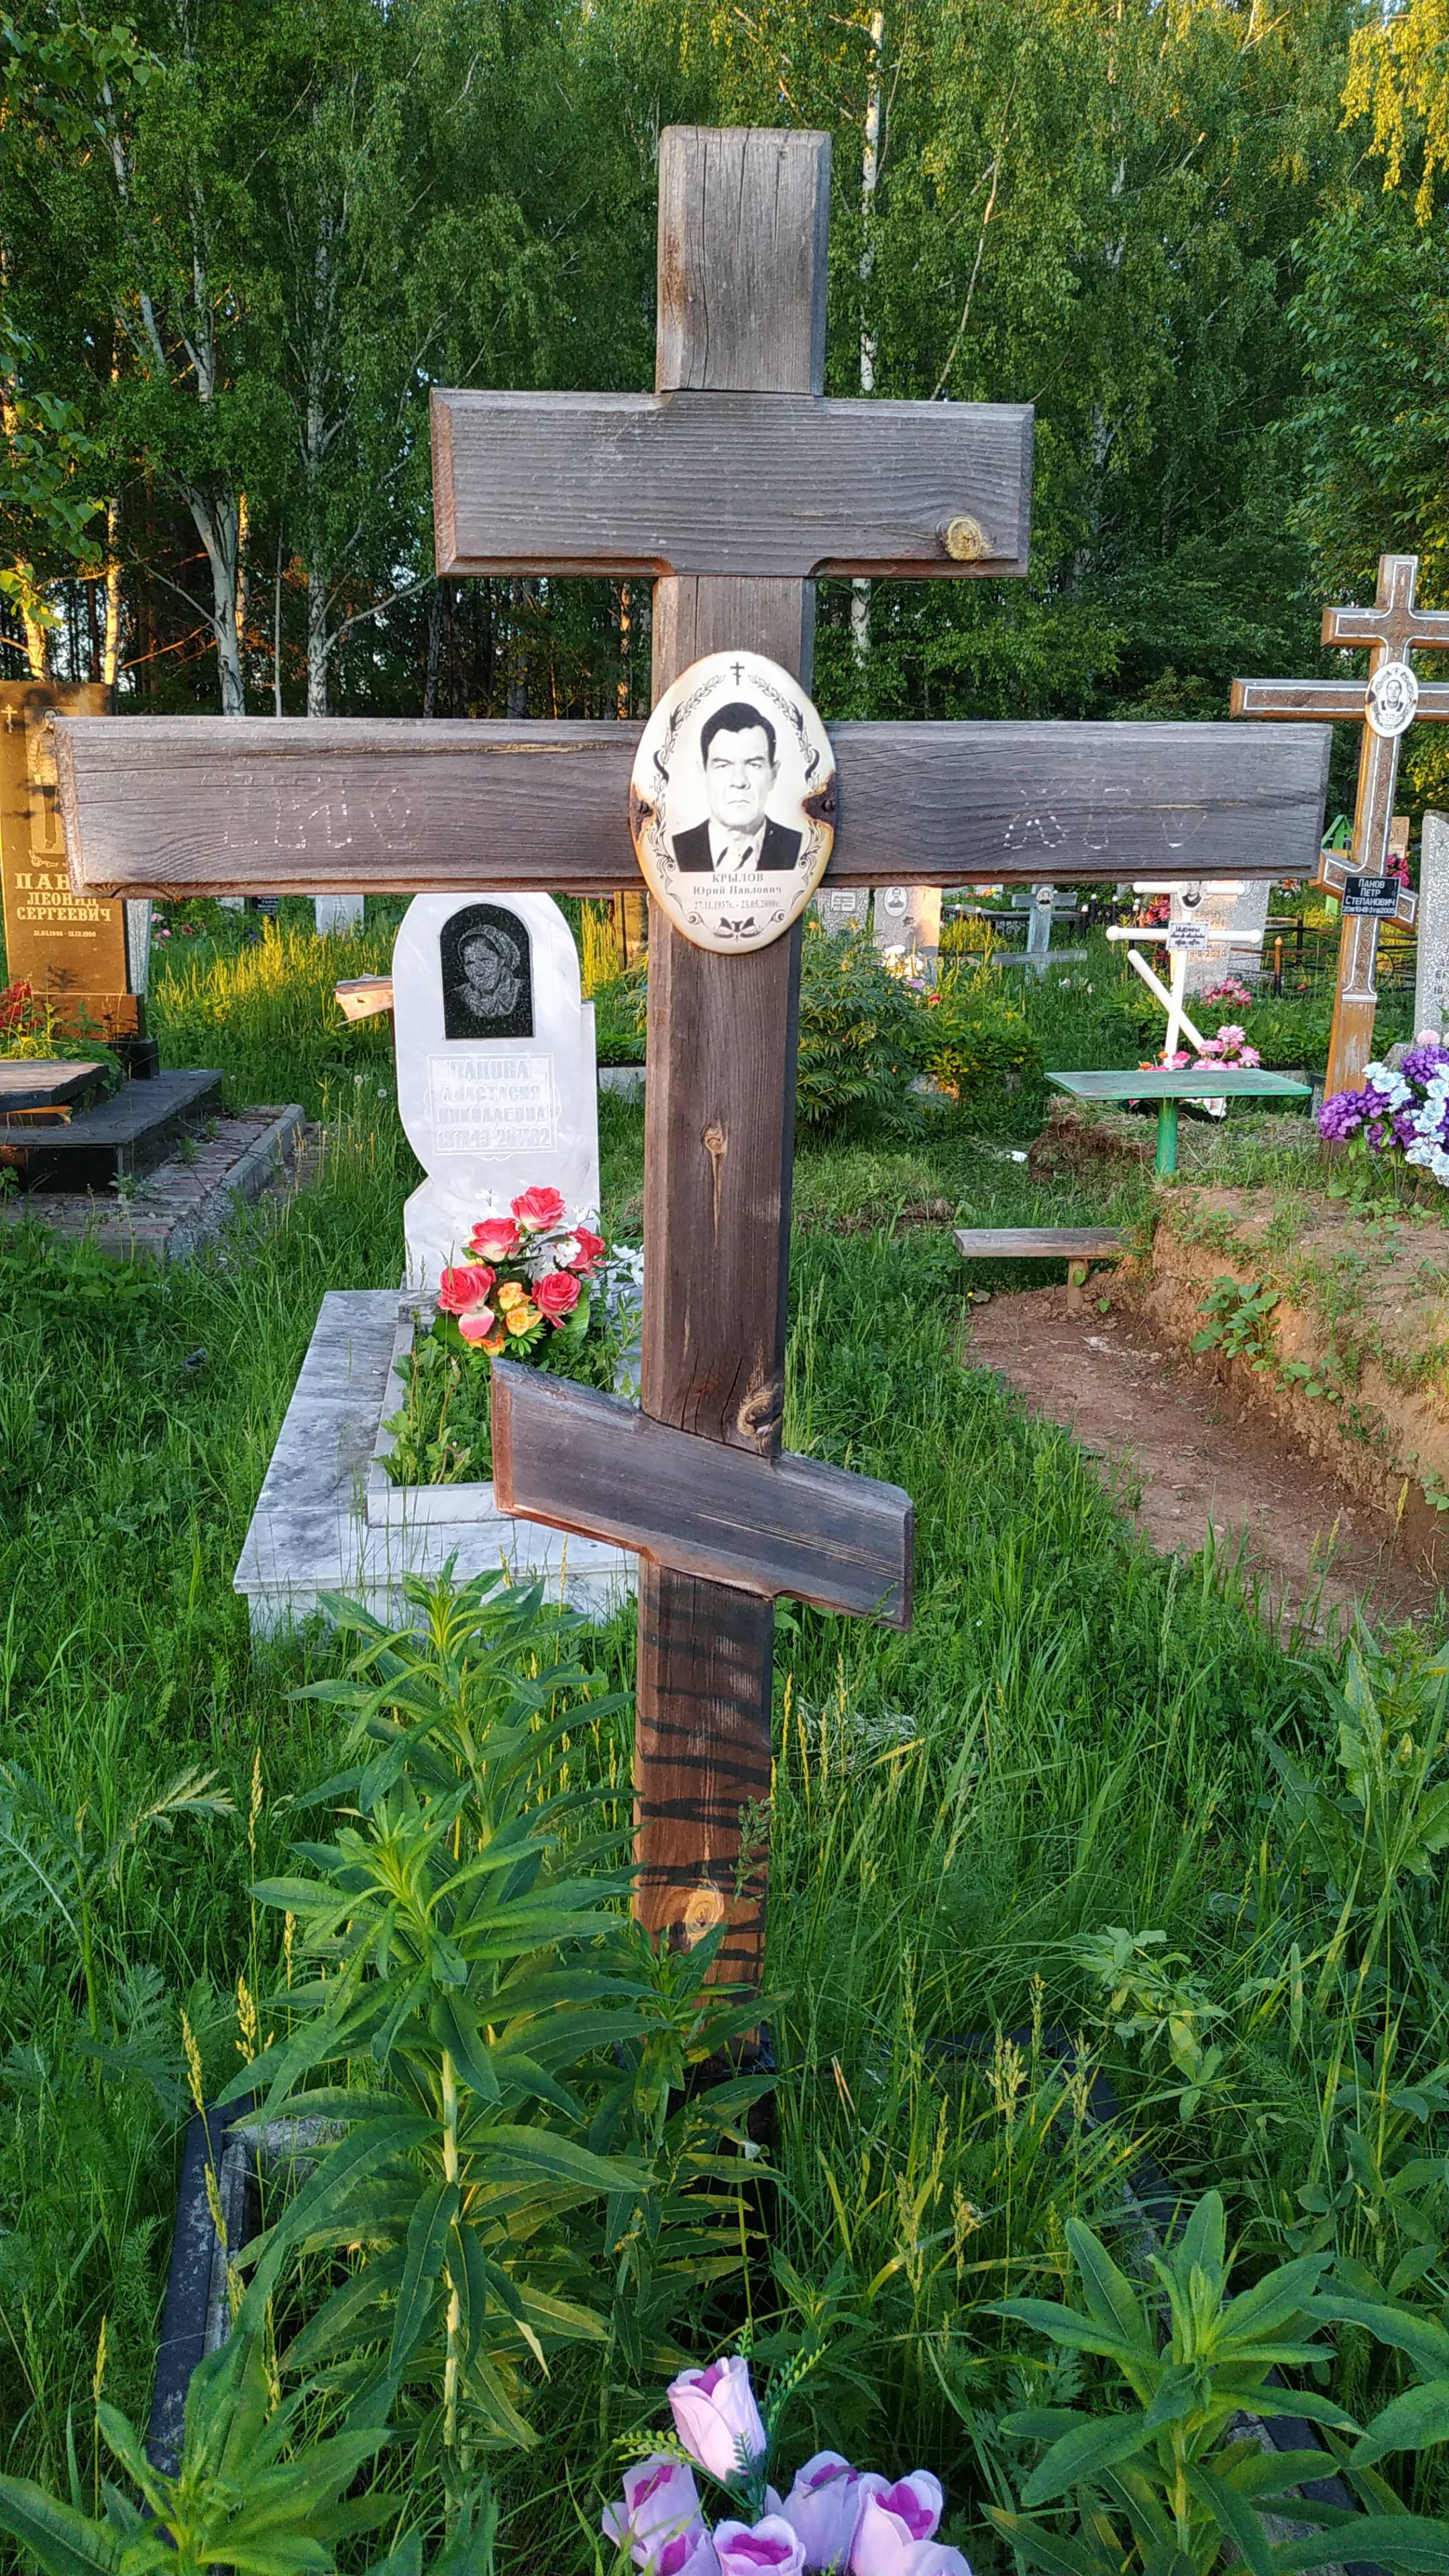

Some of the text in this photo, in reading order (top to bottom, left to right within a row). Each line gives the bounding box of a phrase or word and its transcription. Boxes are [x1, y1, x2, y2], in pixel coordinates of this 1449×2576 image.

[712, 873, 763, 883] КРЫЛОВ
[693, 885, 782, 897] Юрий Павлович
[27, 892, 99, 908] ЛЕОНИД
[17, 907, 111, 922] СЕРГЕЕВИЧ
